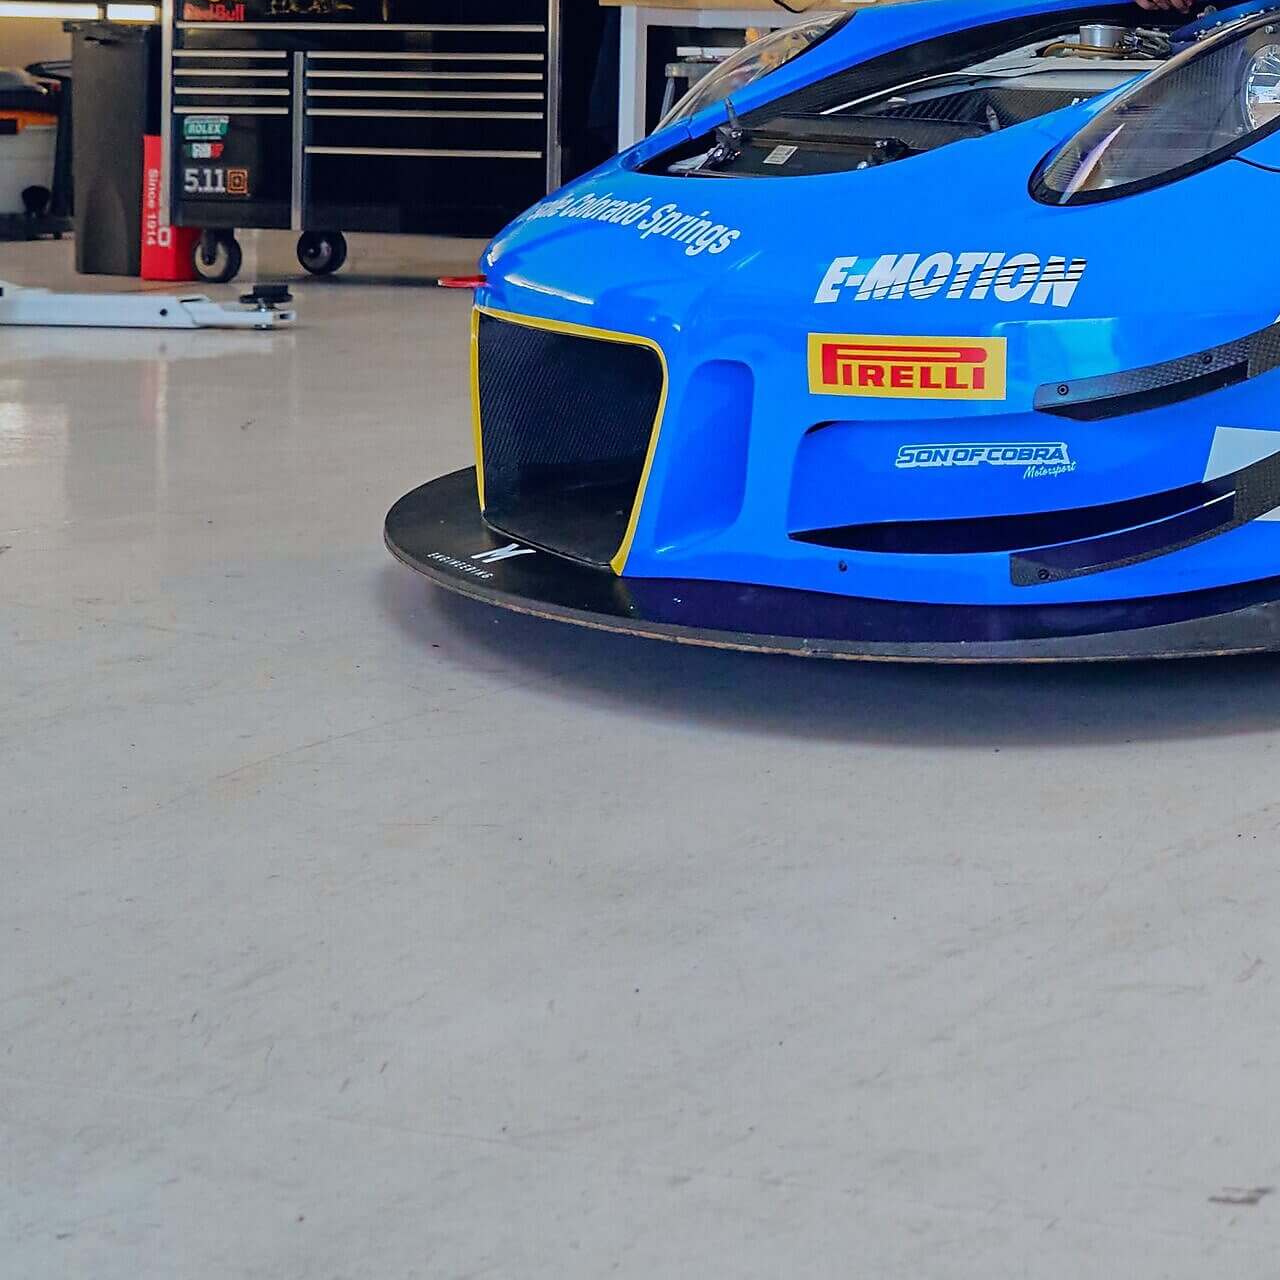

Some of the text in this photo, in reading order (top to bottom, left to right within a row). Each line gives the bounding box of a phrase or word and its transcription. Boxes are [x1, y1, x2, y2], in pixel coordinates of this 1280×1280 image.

[145, 168, 159, 246] Since 1914
[561, 192, 652, 226] Colorado
[637, 203, 741, 257] Springs
[813, 252, 1088, 308] E-MOTION
[821, 343, 989, 391] PIRELLI
[897, 447, 1065, 464] SON OF COBRA
[1023, 461, 1077, 480] Motorsport
